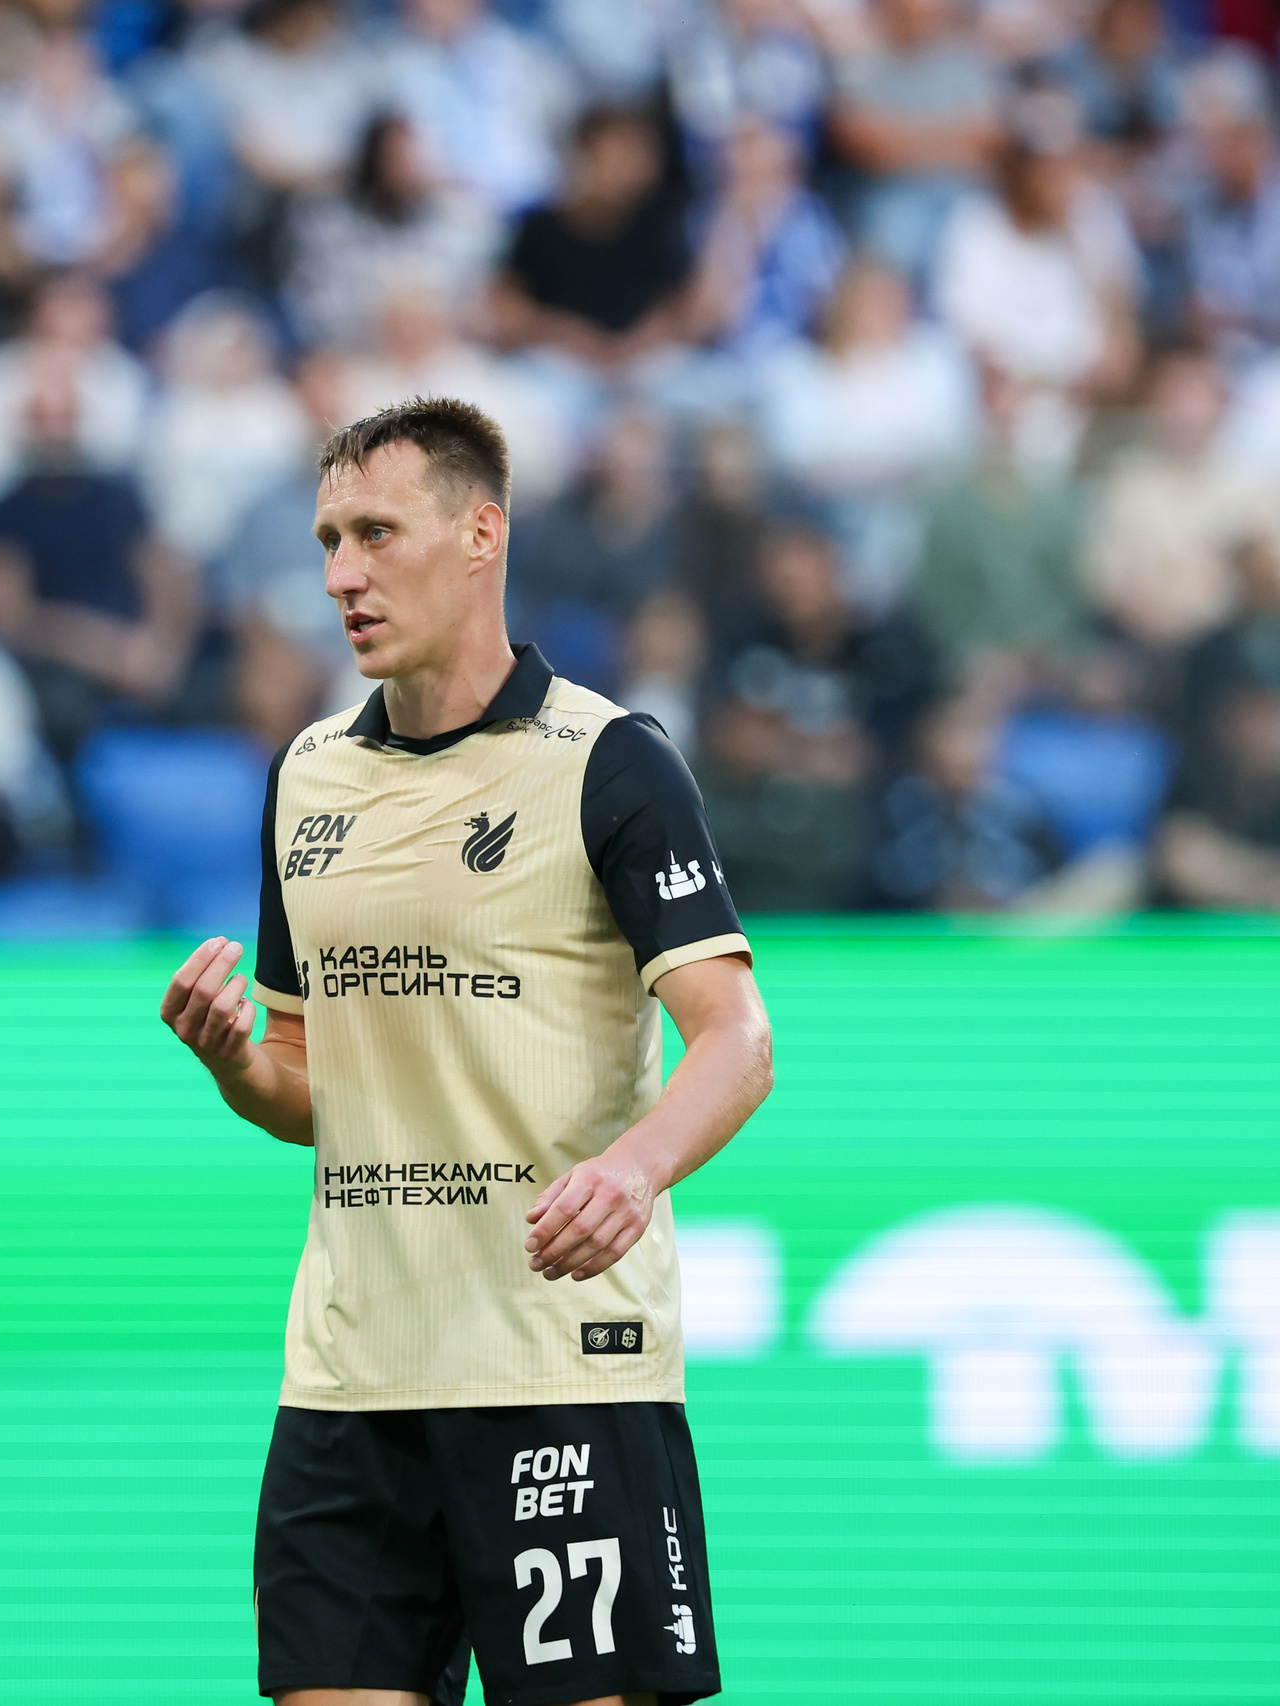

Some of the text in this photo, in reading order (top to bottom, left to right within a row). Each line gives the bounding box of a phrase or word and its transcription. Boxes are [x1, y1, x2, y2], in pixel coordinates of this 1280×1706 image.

[290, 814, 358, 846] FON
[284, 847, 344, 881] BET
[320, 945, 448, 971] КАЗАНЬ
[323, 972, 521, 999] ОРГСИНТЕЗ
[324, 1163, 537, 1185] НИЖНЕКАМСК
[324, 1186, 488, 1208] НЕФТЕХИМ
[511, 1443, 591, 1484] FON
[514, 1480, 595, 1522] BET
[662, 1506, 688, 1591] КОС
[513, 1537, 622, 1666] 27
